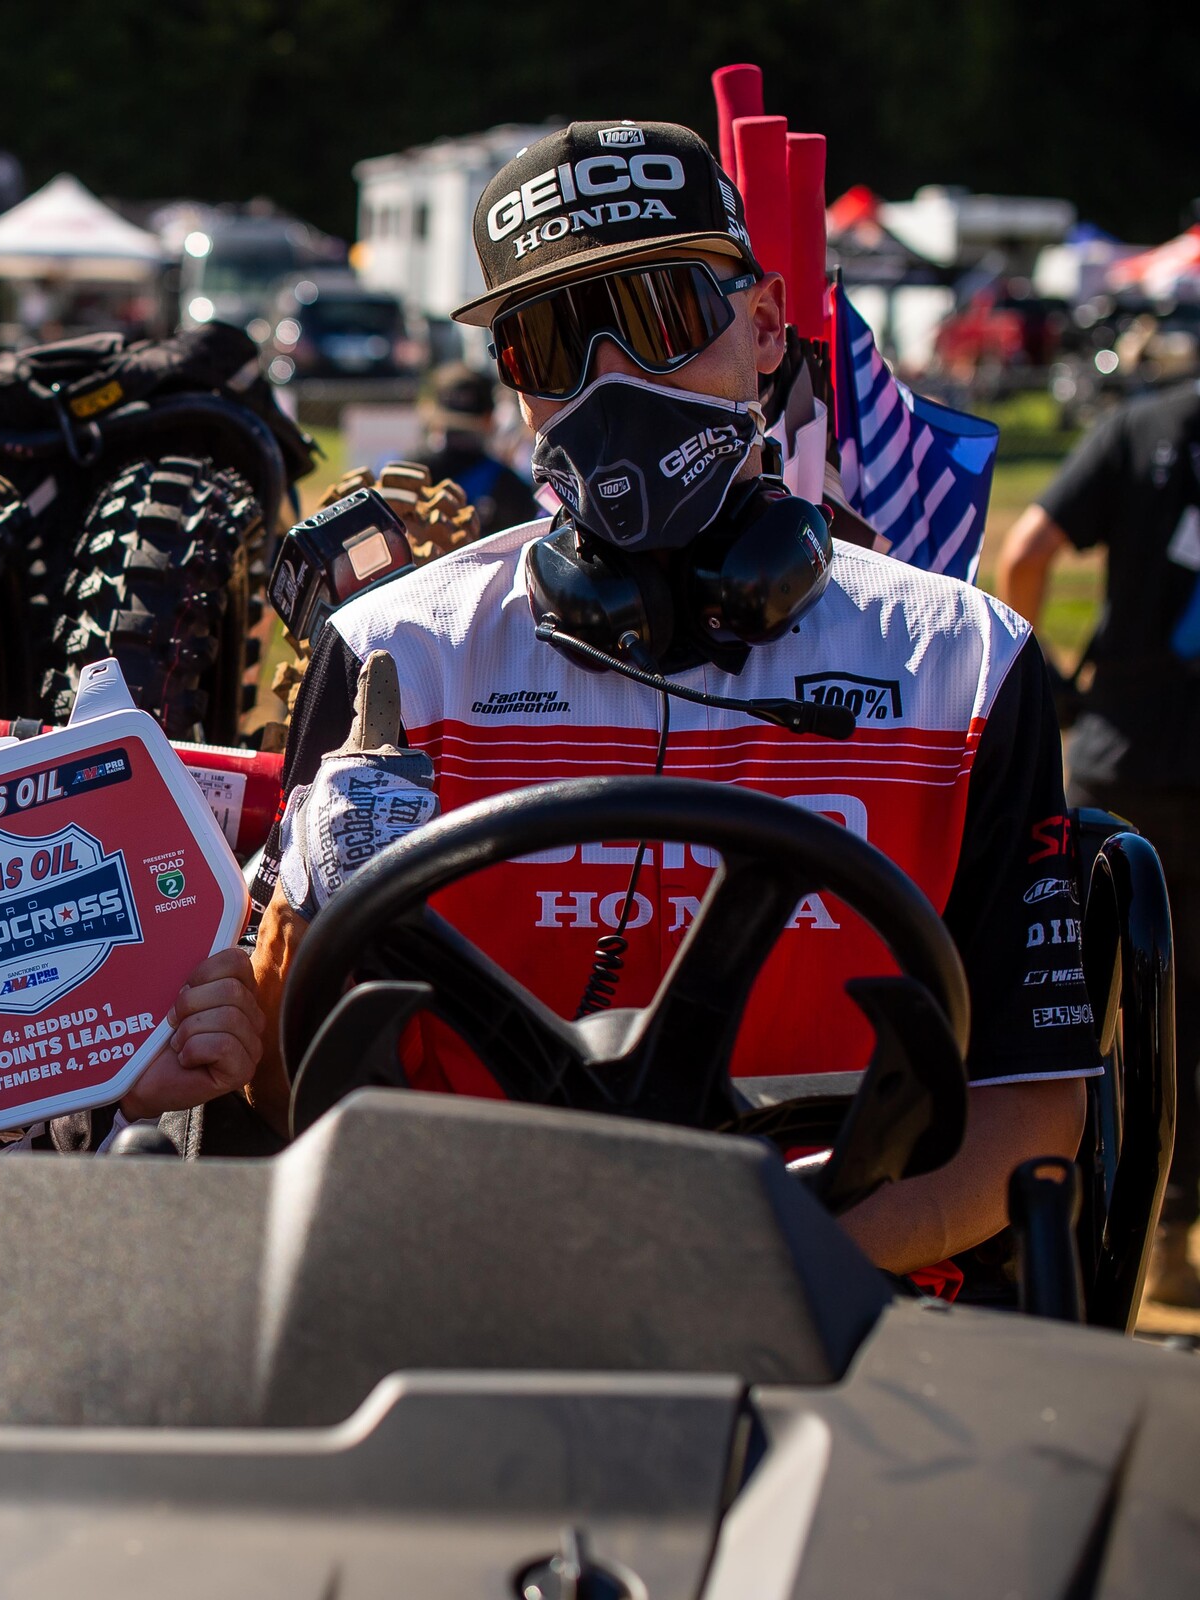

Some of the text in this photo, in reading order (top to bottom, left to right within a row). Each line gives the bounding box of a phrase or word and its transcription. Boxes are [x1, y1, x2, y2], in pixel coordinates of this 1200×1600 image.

[605, 130, 639, 145] 100%
[487, 154, 685, 242] GEICO
[512, 199, 676, 259] HONDA
[681, 438, 745, 487] HONDA
[603, 481, 627, 495] 100%
[488, 690, 558, 704] Factory
[72, 759, 124, 785] AMA PRO
[16, 769, 64, 810] OIL
[143, 852, 177, 864] PRESENTED
[149, 858, 184, 874] ROAD
[166, 879, 179, 895] 2
[155, 895, 197, 914] RECOVERY
[7, 965, 41, 978] SANCTIONED
[36, 967, 58, 980] PRO
[2, 1030, 20, 1044] 4:
[23, 1007, 98, 1039] REDBUD
[102, 1003, 114, 1017] 1
[67, 1012, 156, 1051] LEADER
[66, 1057, 84, 1072] 4,
[88, 1042, 135, 1067] 2020
